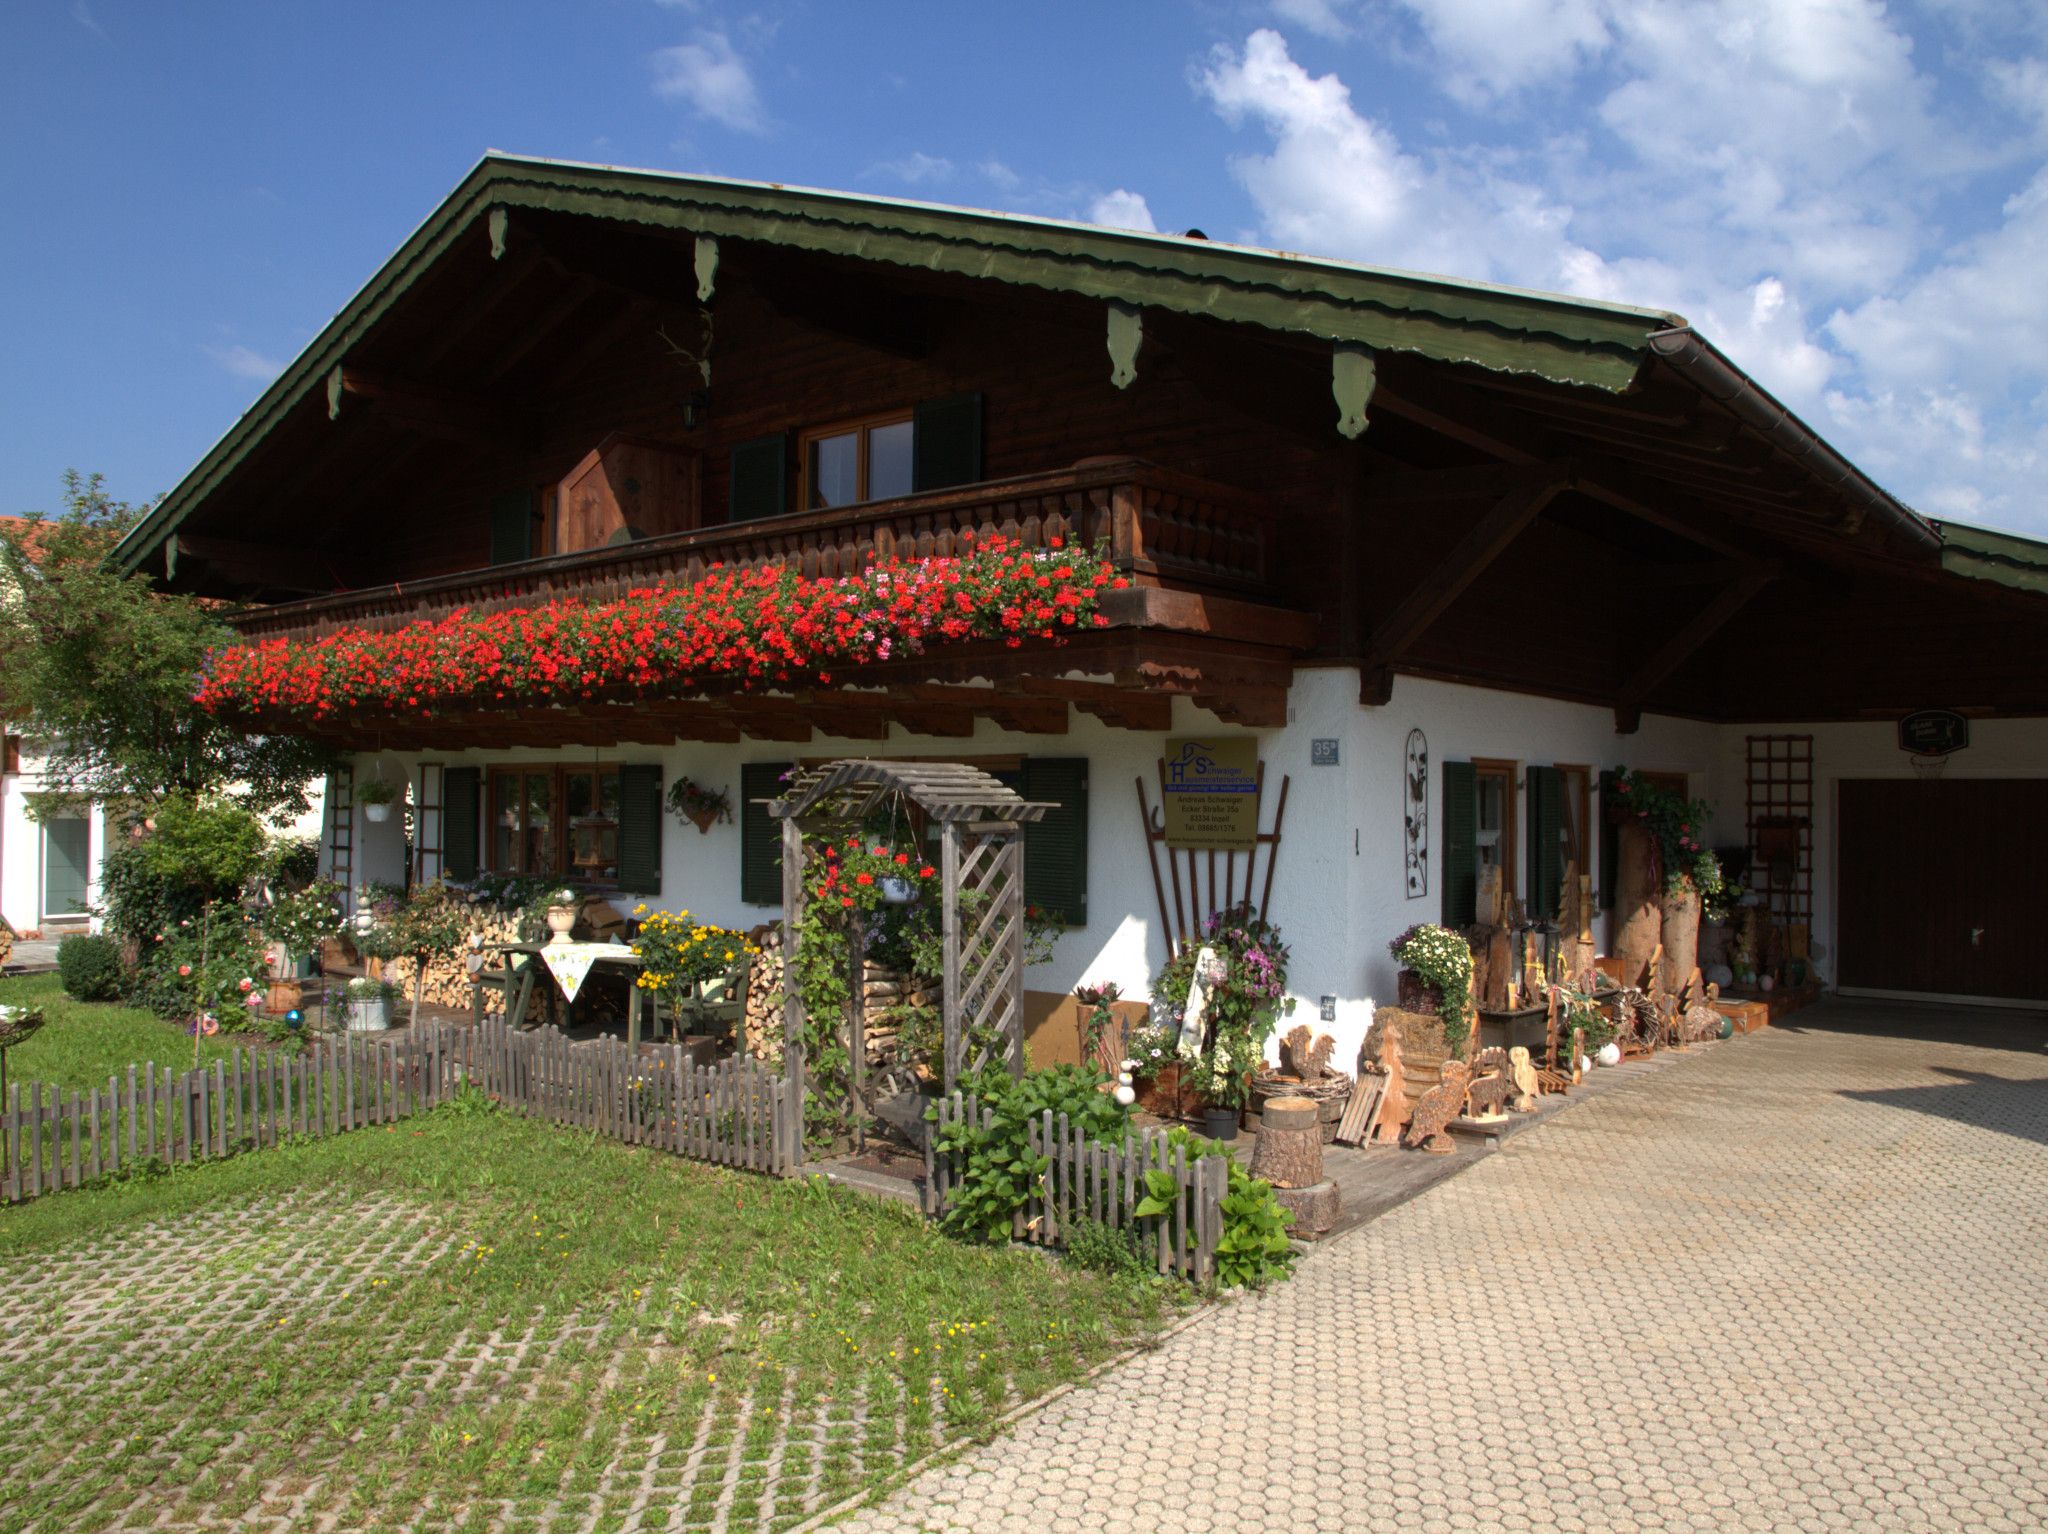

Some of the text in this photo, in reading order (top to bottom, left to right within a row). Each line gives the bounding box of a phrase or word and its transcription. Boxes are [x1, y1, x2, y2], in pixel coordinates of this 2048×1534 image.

[1195, 757, 1242, 776] Schwaiger
[1172, 764, 1255, 783] Hausmeisterservice
[1208, 796, 1243, 805] Schwaiger
[1203, 805, 1224, 813] Straße
[1211, 814, 1229, 823] Inzell
